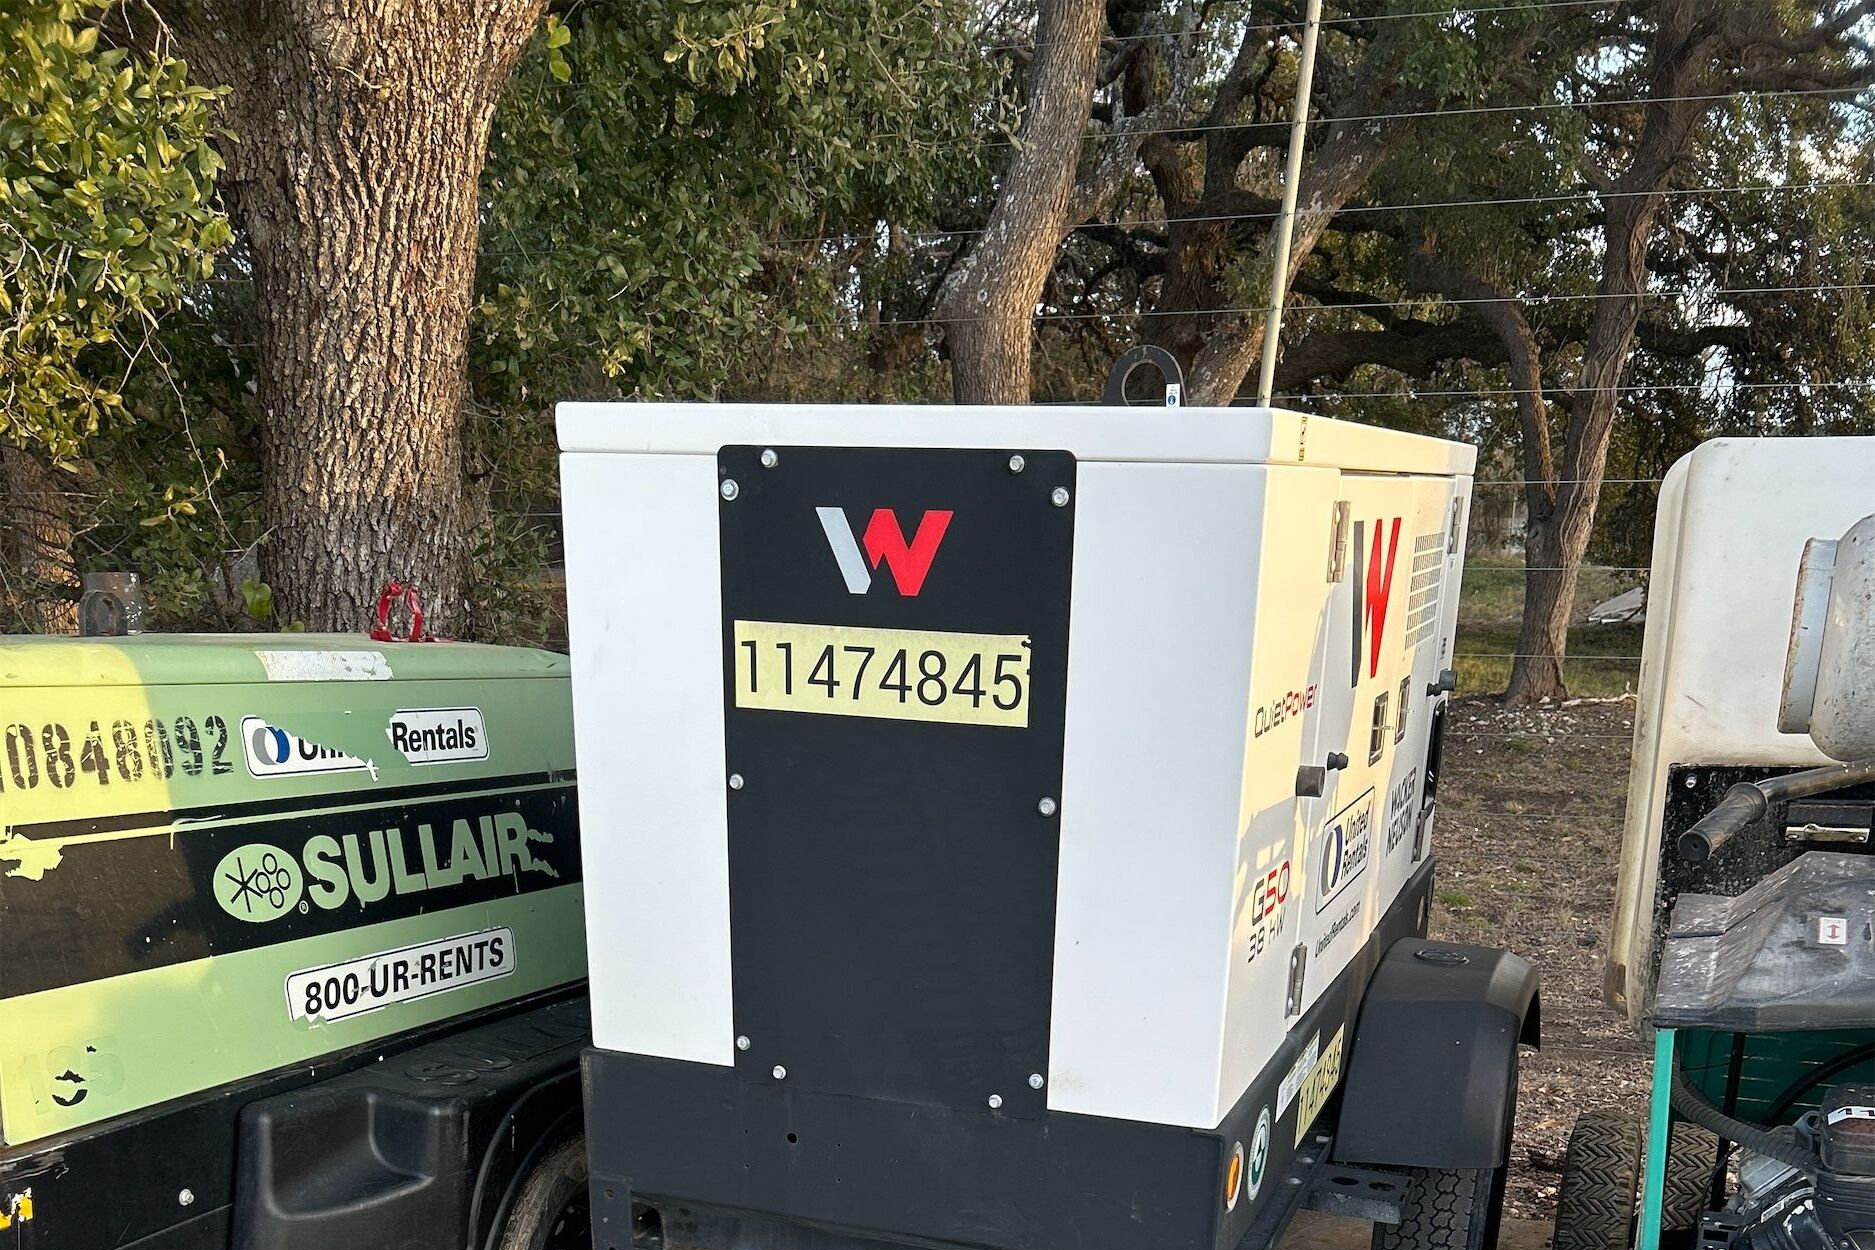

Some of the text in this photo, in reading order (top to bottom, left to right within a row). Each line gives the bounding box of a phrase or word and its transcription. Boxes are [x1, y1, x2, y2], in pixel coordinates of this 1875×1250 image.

[741, 640, 1023, 710] 11474845
[0, 715, 235, 793] 0848092
[391, 719, 476, 753] Rentals
[1345, 798, 1372, 846] United
[302, 811, 540, 910] SULLAIR
[1340, 834, 1368, 880] Rentals
[1252, 859, 1290, 927] G50
[304, 936, 505, 1016] 800-UR-RENTS
